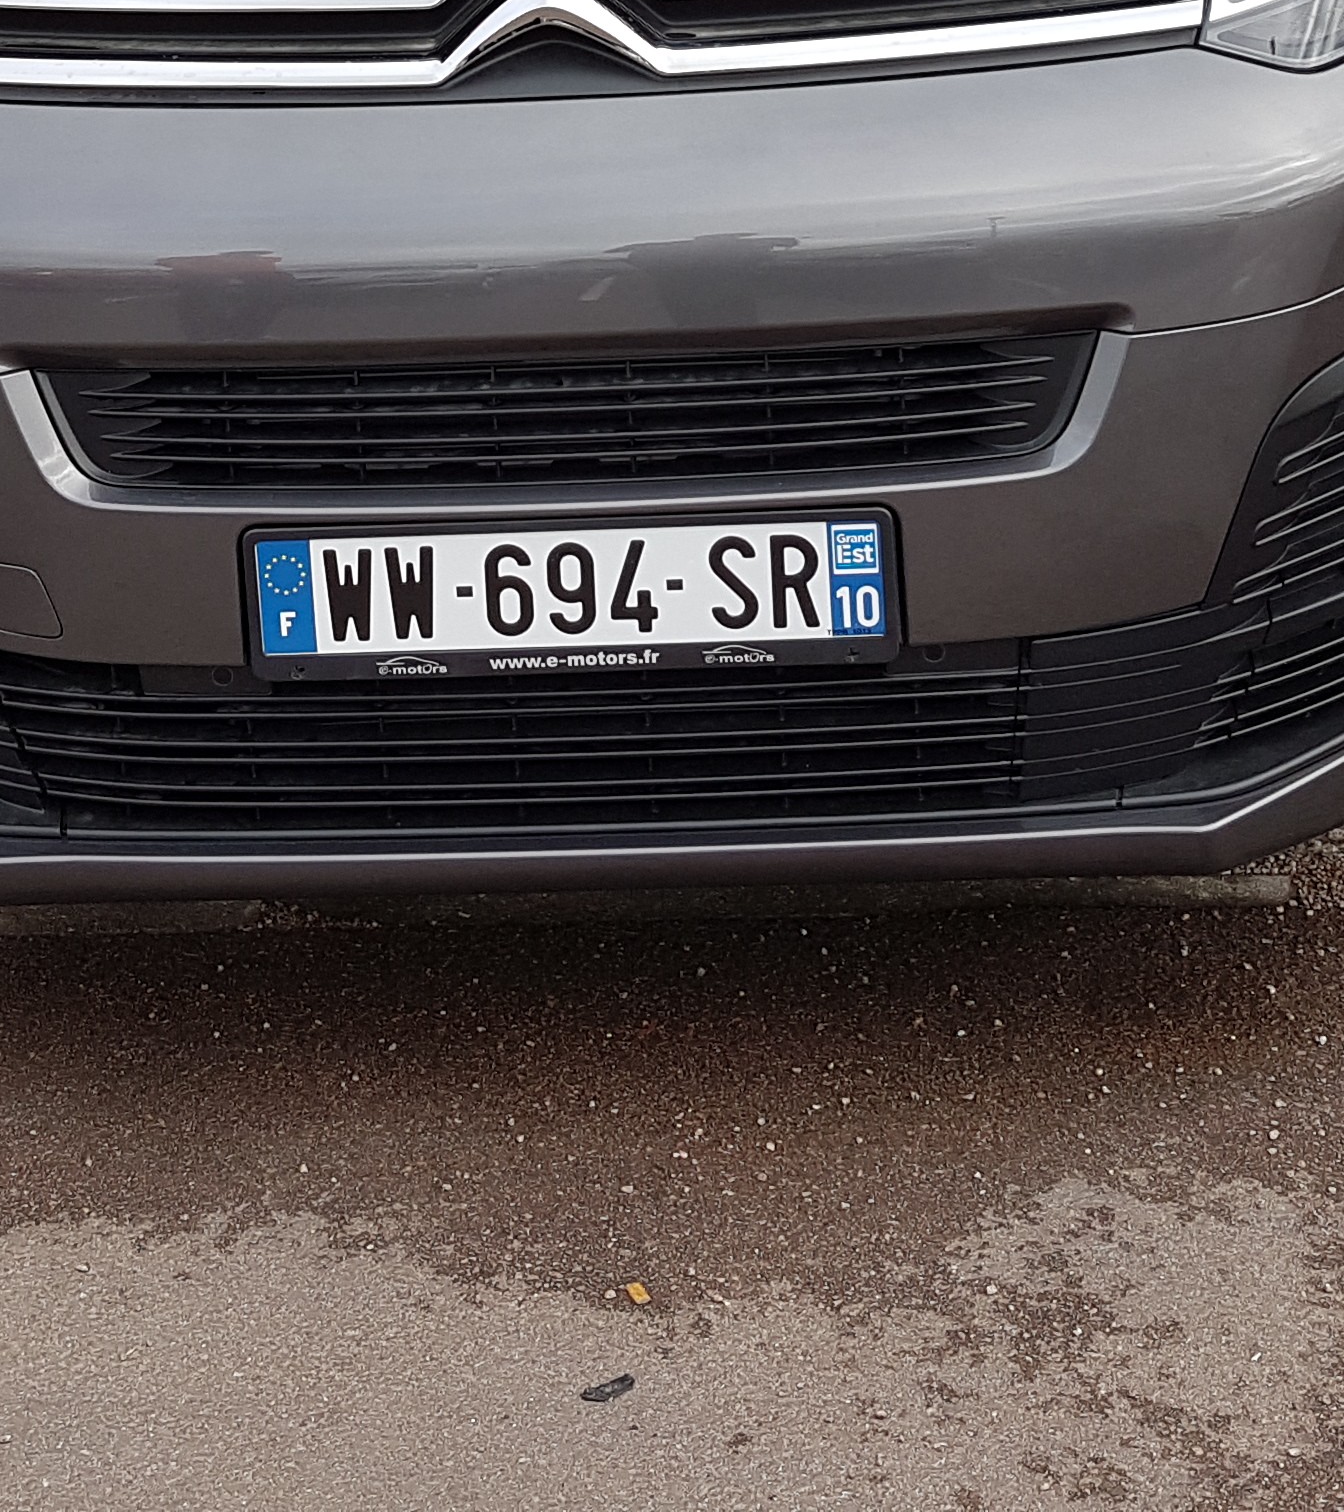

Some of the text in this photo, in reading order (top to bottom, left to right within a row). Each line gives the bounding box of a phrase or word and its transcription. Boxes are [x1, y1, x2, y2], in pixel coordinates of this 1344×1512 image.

[836, 532, 874, 544] Grand
[836, 544, 875, 564] Est
[836, 585, 880, 629] 10
[279, 611, 297, 637] F
[489, 649, 660, 670] www.e-motors.fr
